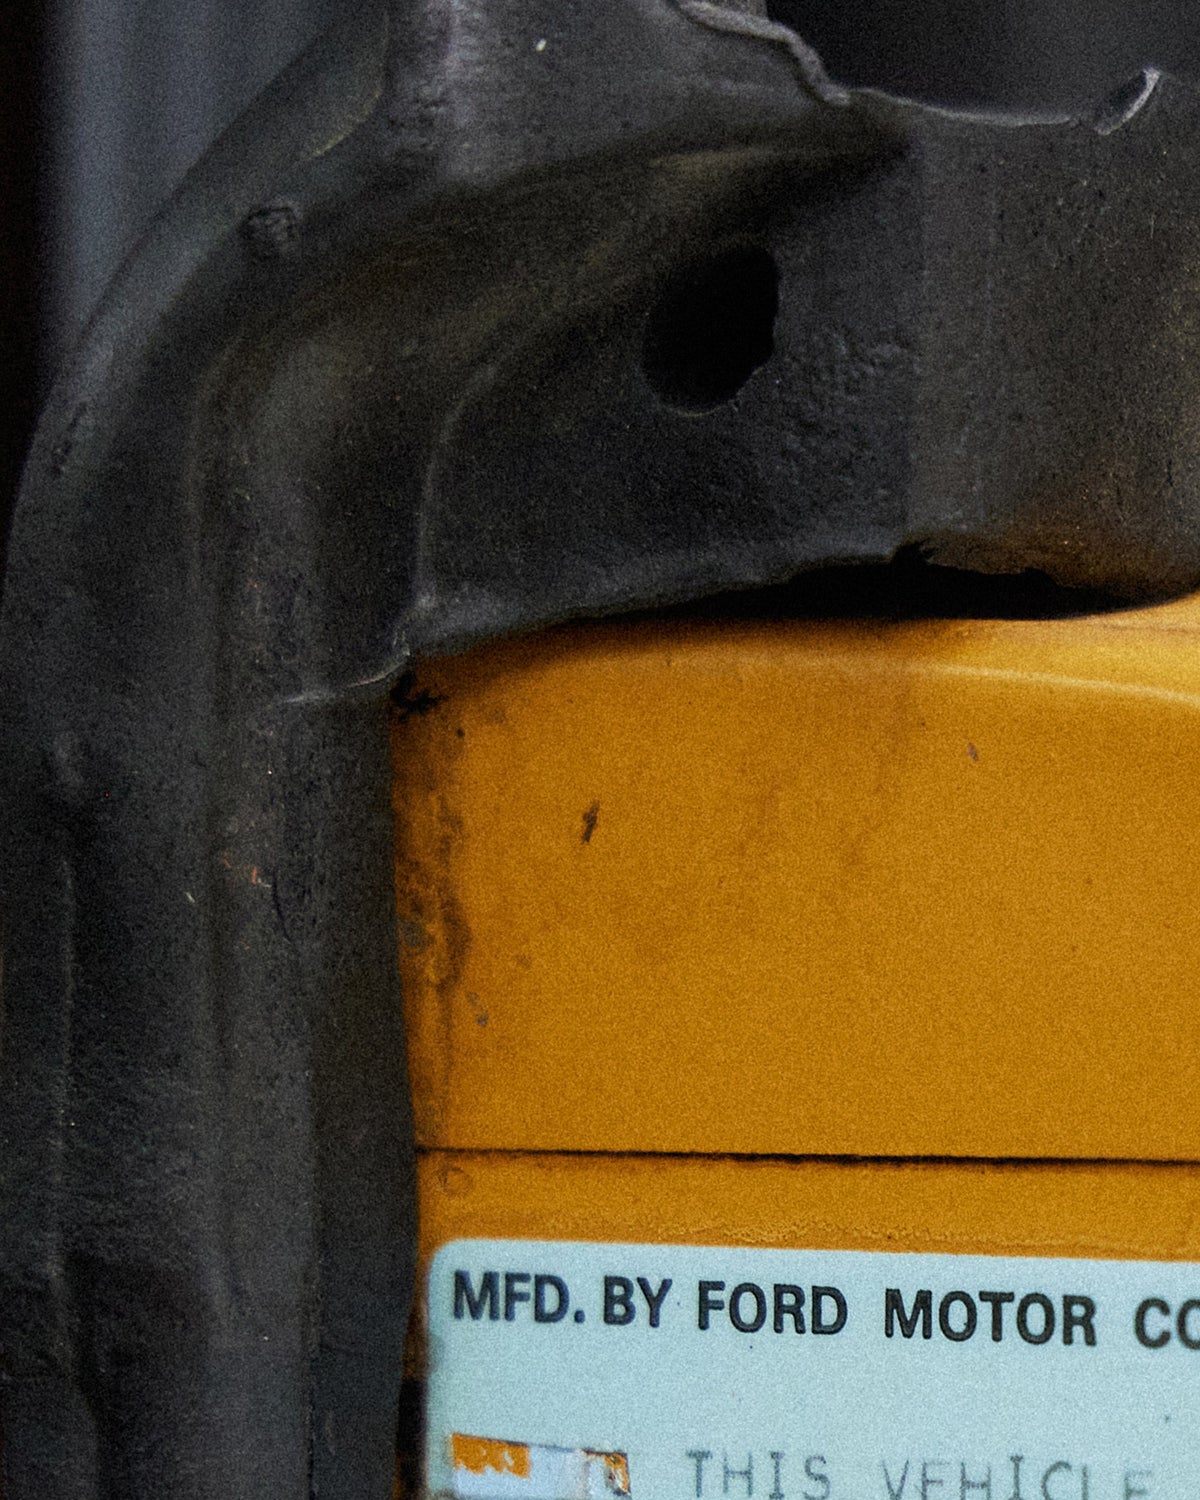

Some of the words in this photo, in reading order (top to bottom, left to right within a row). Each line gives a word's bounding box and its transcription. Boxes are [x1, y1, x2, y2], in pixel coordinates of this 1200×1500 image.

[453, 1269, 585, 1324] MFD.
[602, 1275, 672, 1328] BY
[697, 1280, 848, 1334] FORD
[884, 1288, 1097, 1346] MOTOR
[686, 1450, 831, 1500] THIS
